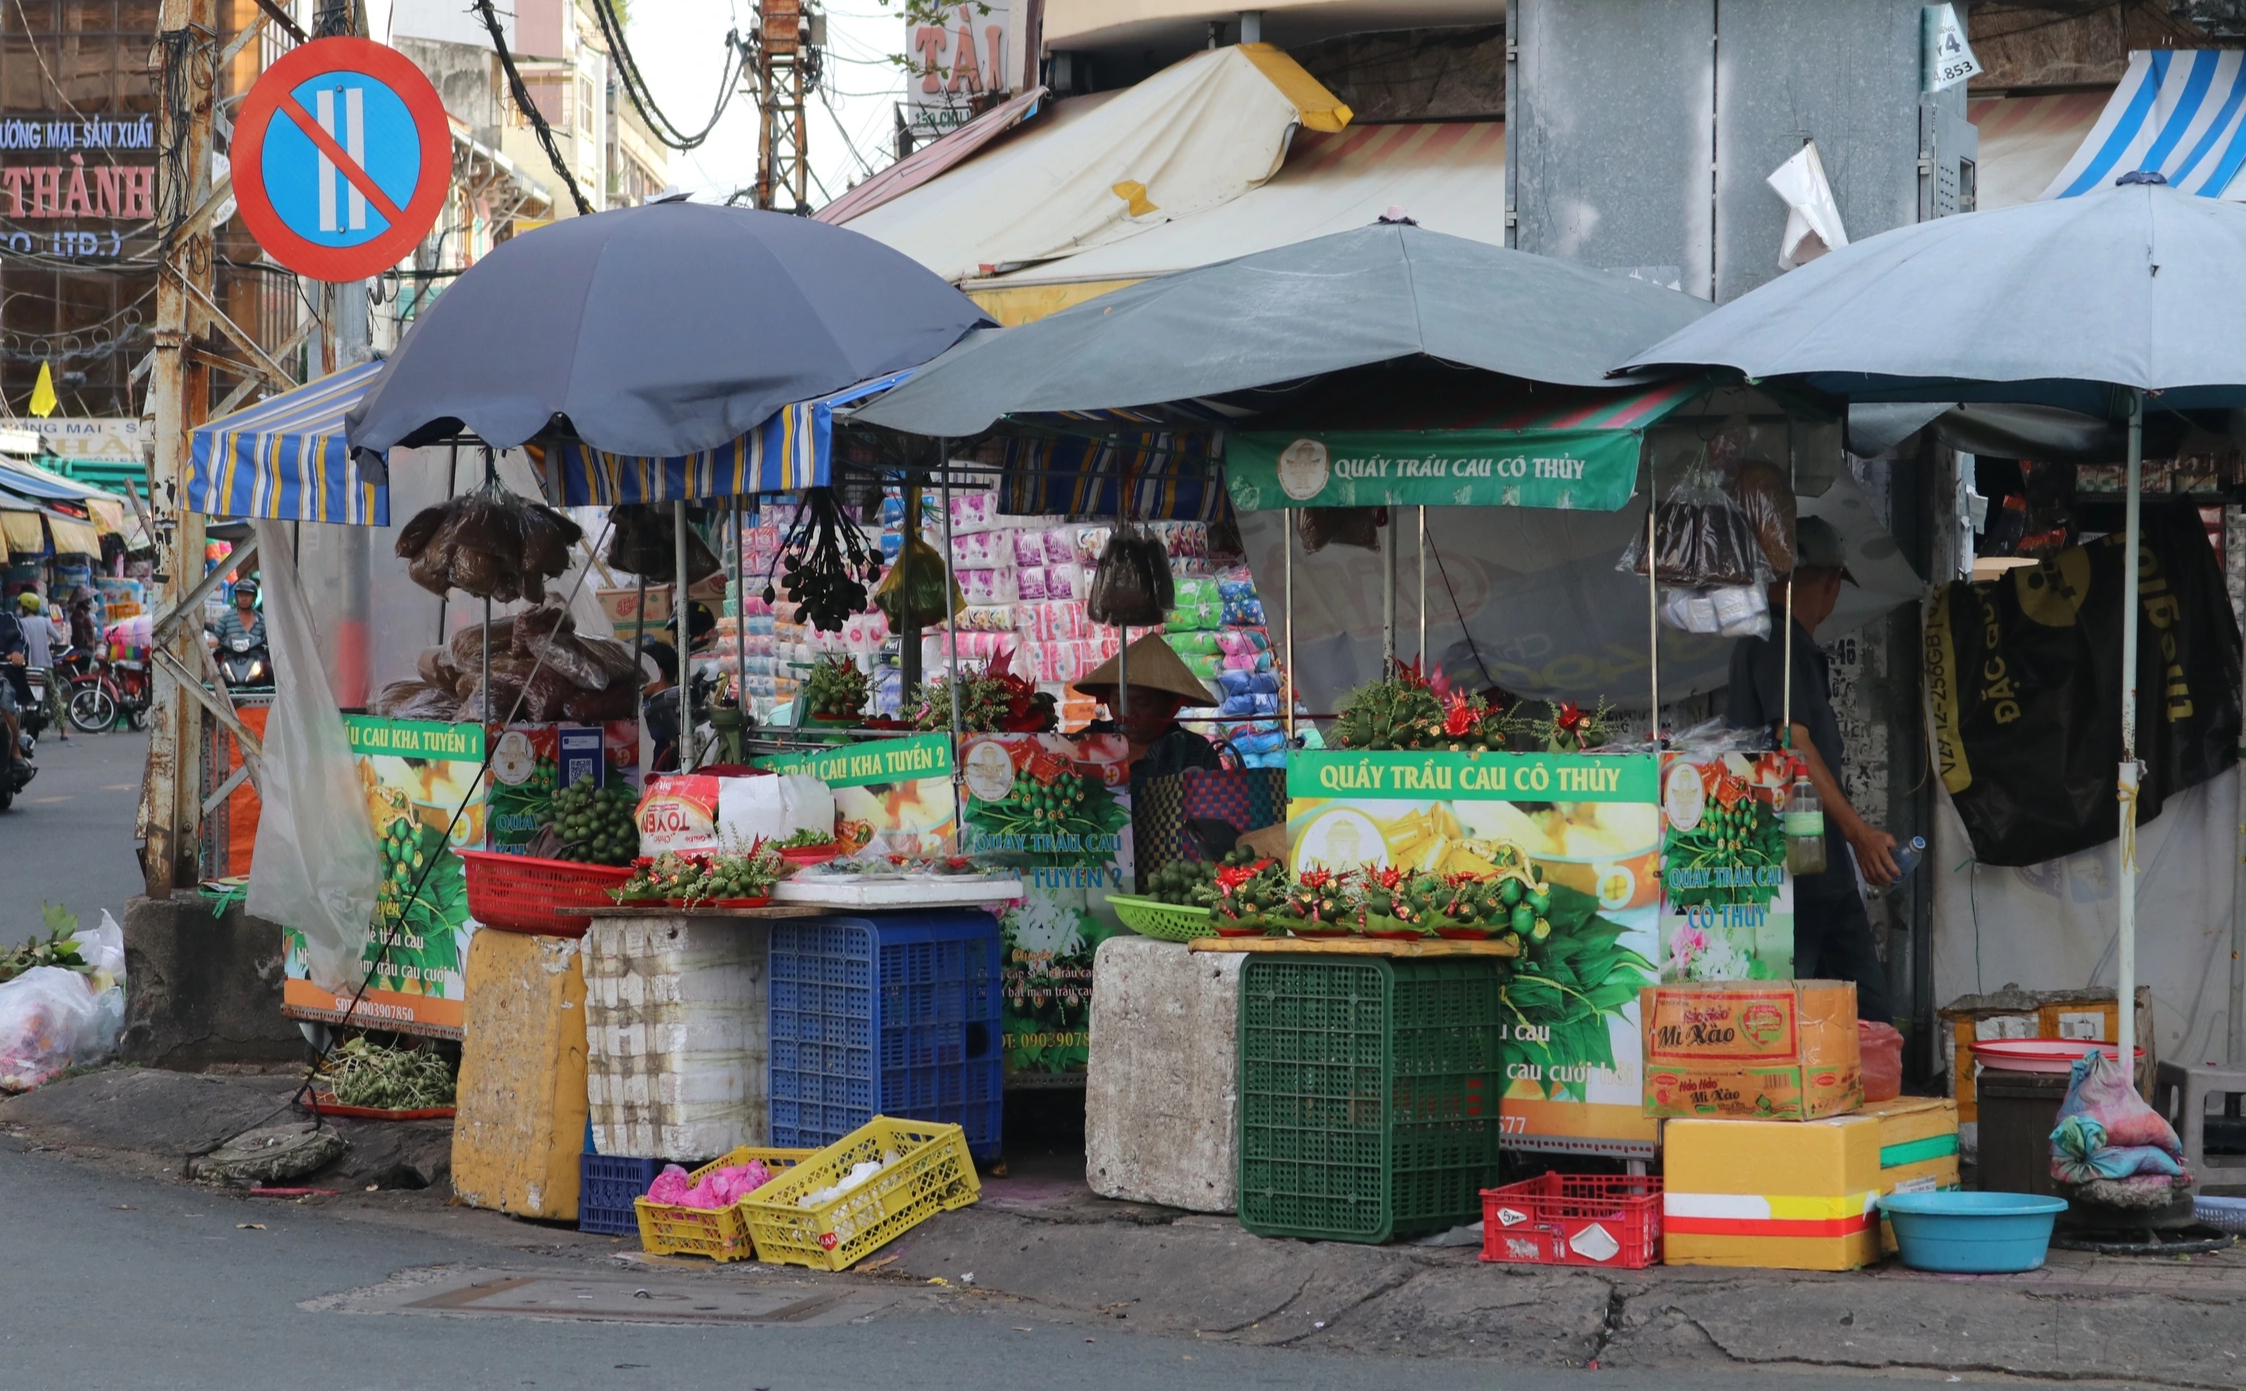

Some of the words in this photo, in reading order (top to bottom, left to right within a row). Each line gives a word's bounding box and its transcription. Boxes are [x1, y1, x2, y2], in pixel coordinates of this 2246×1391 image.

[915, 4, 1003, 94] TÀI
[117, 113, 153, 149] XUẤT
[3, 152, 155, 219] THÀNH
[66, 423, 101, 436] MẠI
[1334, 453, 1392, 480] QUẦY
[1395, 453, 1446, 478] TRẦU
[1452, 458, 1493, 478] CAU
[1532, 453, 1586, 480] THỦY
[363, 727, 389, 747] CAU
[392, 729, 419, 750] KHA
[423, 727, 465, 753] TUYỀN
[471, 735, 477, 754] 1
[851, 754, 882, 777] KHA
[886, 742, 933, 772] TUYỀN
[937, 746, 945, 767] 2
[1320, 758, 1386, 791] QUẦY
[1390, 759, 1451, 790] TRẦU
[1459, 765, 1506, 791] CAU
[1513, 762, 1549, 791] CÔ
[1556, 760, 1621, 792] THỦY
[1085, 833, 1122, 852] CAU
[1034, 859, 1103, 888] TUYỀN
[1111, 866, 1123, 888] 2
[1669, 861, 1711, 889] QUẦY
[1714, 860, 1754, 888] TRẦU
[1757, 865, 1785, 886] CAU
[1688, 898, 1715, 930] CÔ
[1721, 895, 1768, 928] THỦY
[404, 935, 424, 949] cau
[401, 966, 420, 980] cau
[356, 1000, 414, 1022] 0903907850
[1514, 1023, 1550, 1041] cau
[1658, 1024, 1682, 1048] Mì
[1686, 1022, 1735, 1046] Xào
[1506, 1062, 1542, 1080] cau
[1550, 1061, 1592, 1084] cưới
[1679, 1078, 1697, 1092] Hảo
[1699, 1076, 1718, 1090] Hảo
[820, 1234, 837, 1246] AAA
